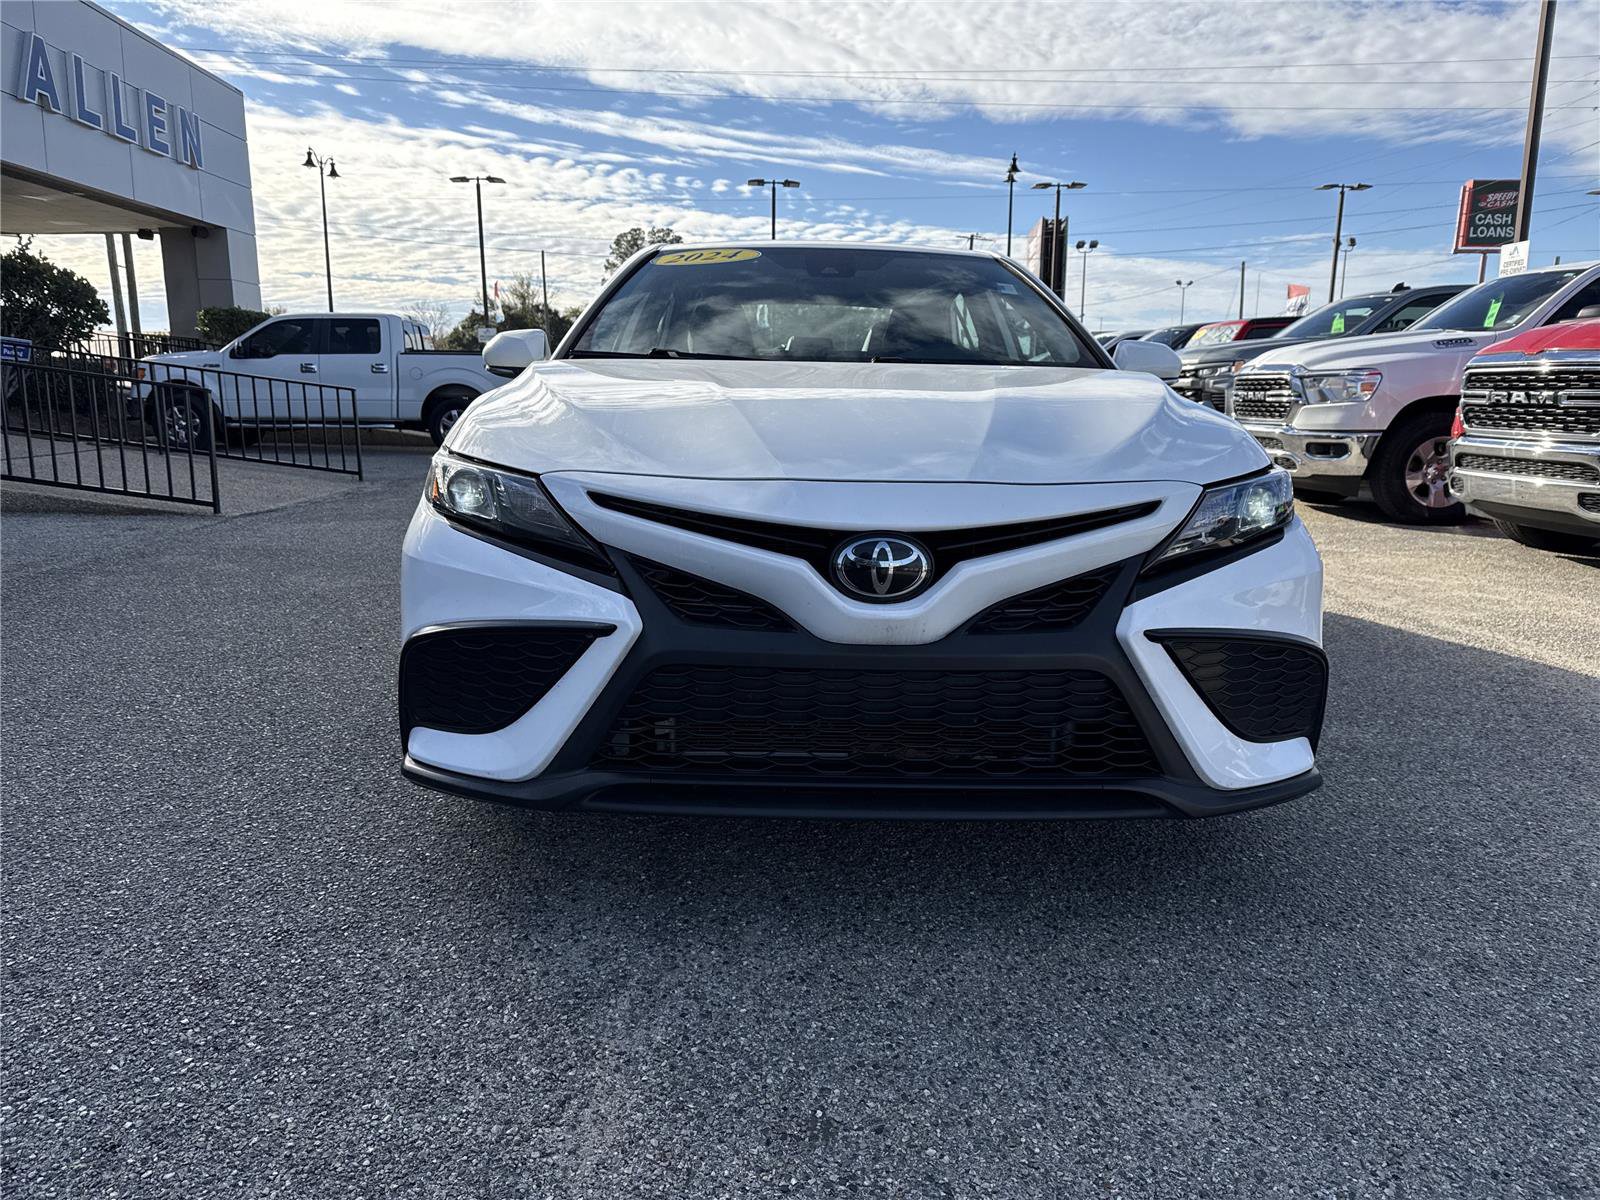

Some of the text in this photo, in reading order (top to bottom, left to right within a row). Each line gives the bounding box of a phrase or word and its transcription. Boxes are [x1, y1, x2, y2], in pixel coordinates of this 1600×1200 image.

[20, 32, 204, 169] ALLEN
[1487, 191, 1518, 202] SPEEDY
[1487, 200, 1514, 208] CASH
[1475, 213, 1512, 225] CASH
[1469, 226, 1514, 238] LOANS
[663, 249, 743, 264] 2024
[1503, 259, 1525, 268] CERTIFIED
[1490, 391, 1554, 404] RAM
